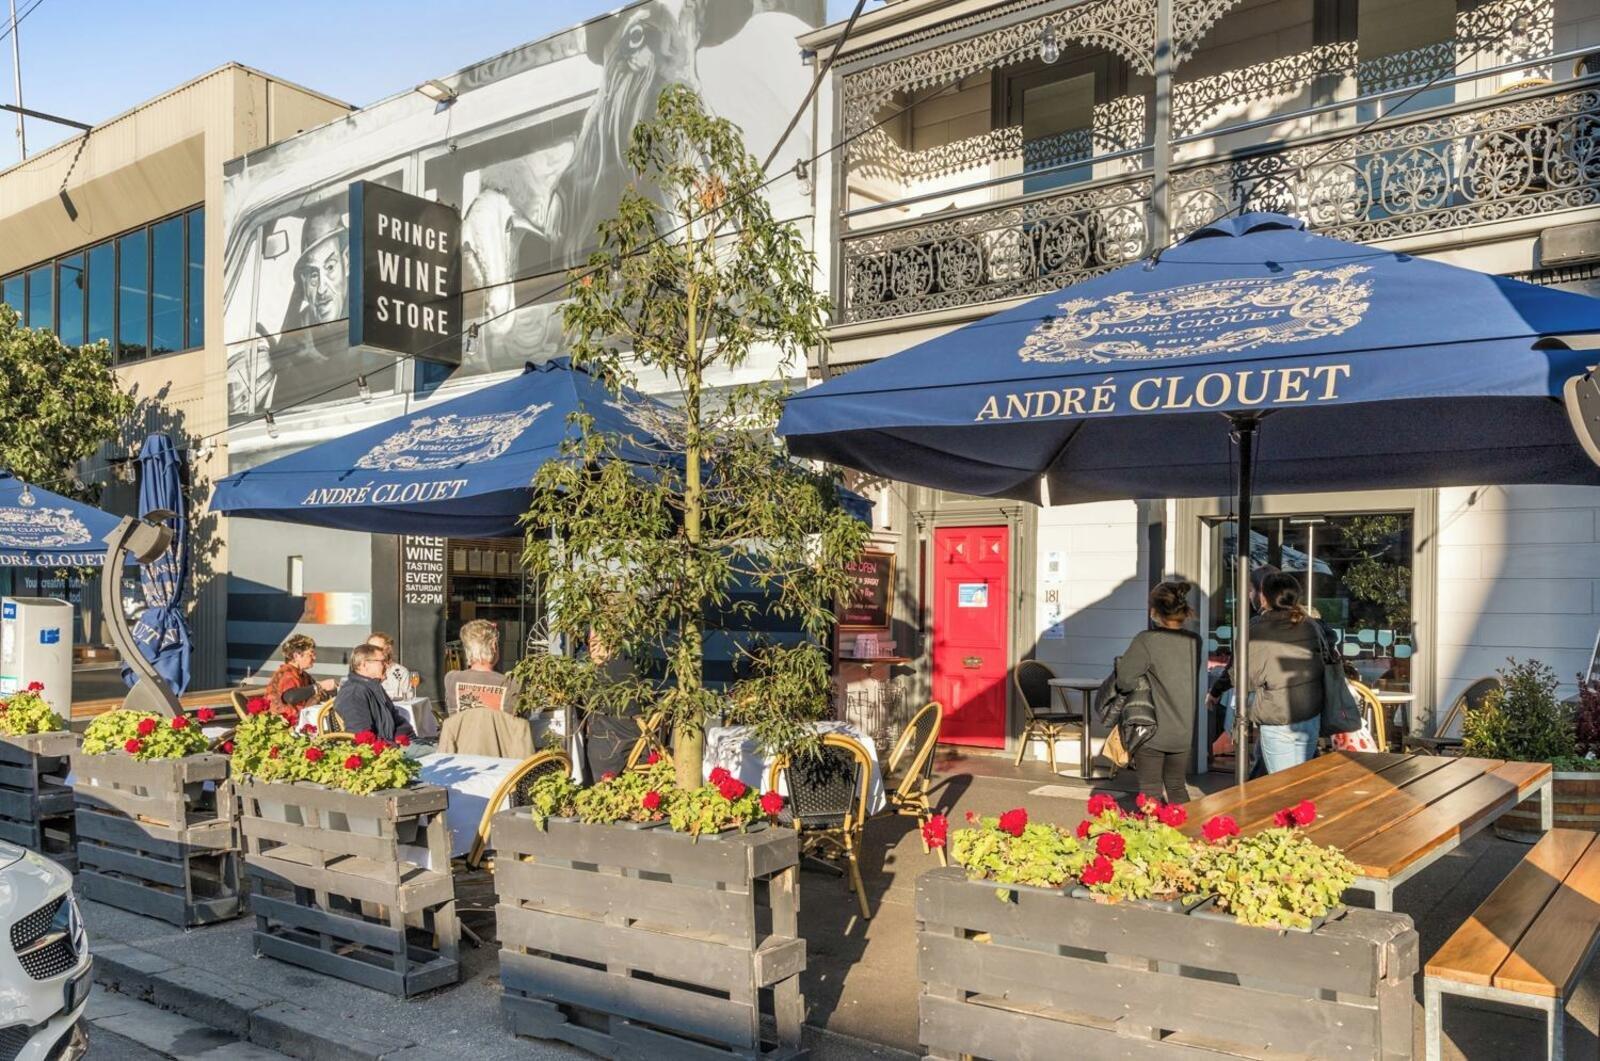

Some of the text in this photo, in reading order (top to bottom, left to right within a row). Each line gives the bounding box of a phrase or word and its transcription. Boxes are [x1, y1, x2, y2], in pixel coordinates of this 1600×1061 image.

[378, 213, 448, 253] PRINCE
[378, 250, 448, 297] WINE
[377, 296, 448, 335] STORE
[1096, 319, 1172, 336] ANDRÉ
[1177, 309, 1286, 330] CLOUET
[1136, 307, 1252, 324] CHAMPAGNE
[1155, 336, 1205, 345] BRUT
[974, 364, 1351, 422] ANDRÉ CLOUET
[301, 479, 468, 505] ANDRÉ CLOUET
[405, 535, 444, 547] FREE
[0, 551, 106, 567] DRÉ CLOUET
[406, 547, 443, 561] WINE
[405, 562, 443, 572] TASTING
[405, 572, 443, 583] EVERY
[405, 584, 442, 592] SATURDAY
[405, 593, 443, 604] 12-2PM
[1045, 589, 1059, 603] 181
